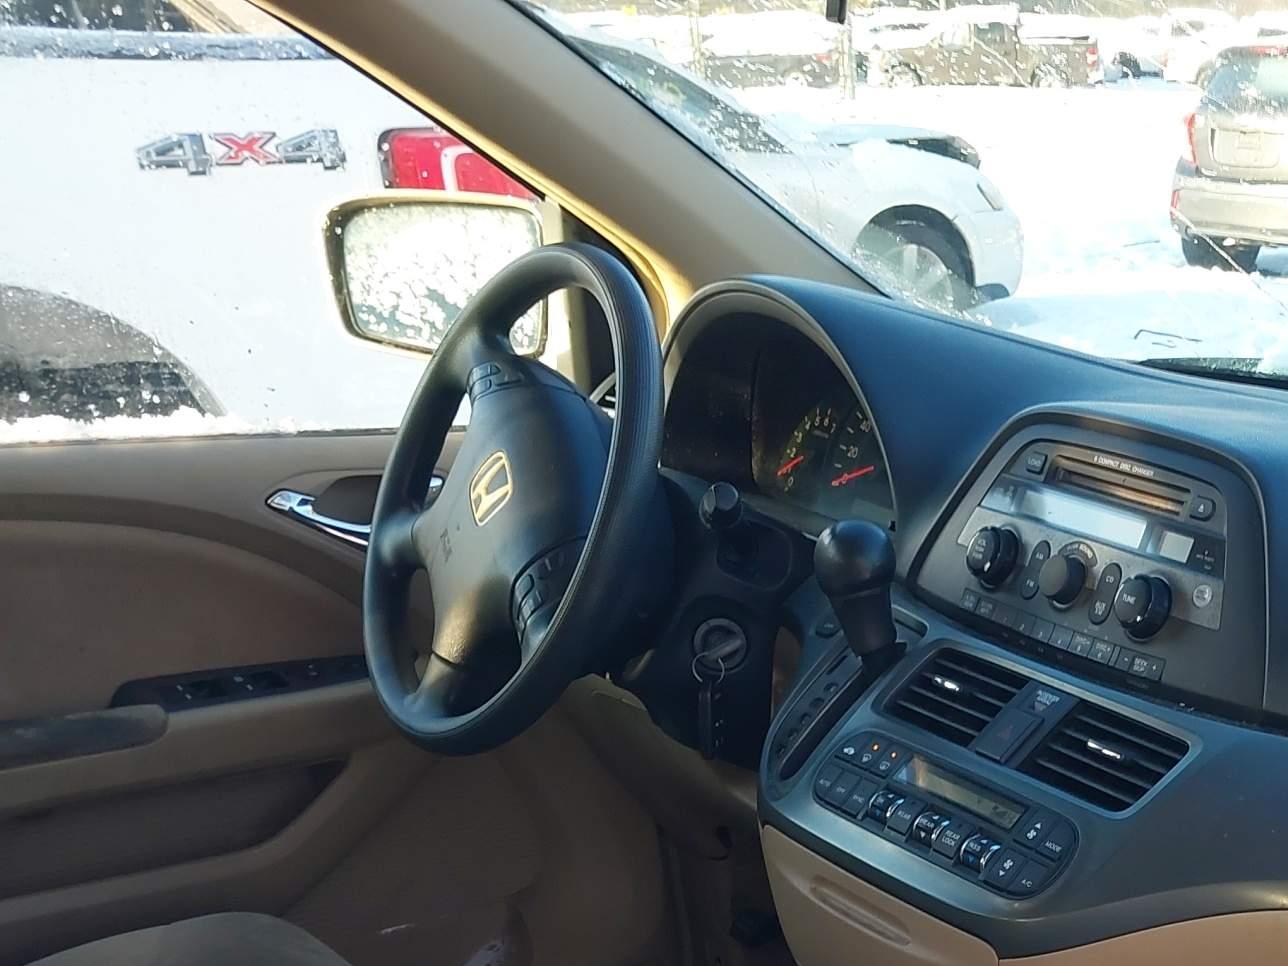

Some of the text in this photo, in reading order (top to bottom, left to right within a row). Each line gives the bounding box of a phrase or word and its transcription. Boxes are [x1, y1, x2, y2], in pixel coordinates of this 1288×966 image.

[1106, 575, 1115, 584] CD
[920, 818, 935, 830] REAR
[945, 829, 961, 841] REAR
[941, 836, 956, 848] LOCK
[1044, 840, 1063, 853] MODE
